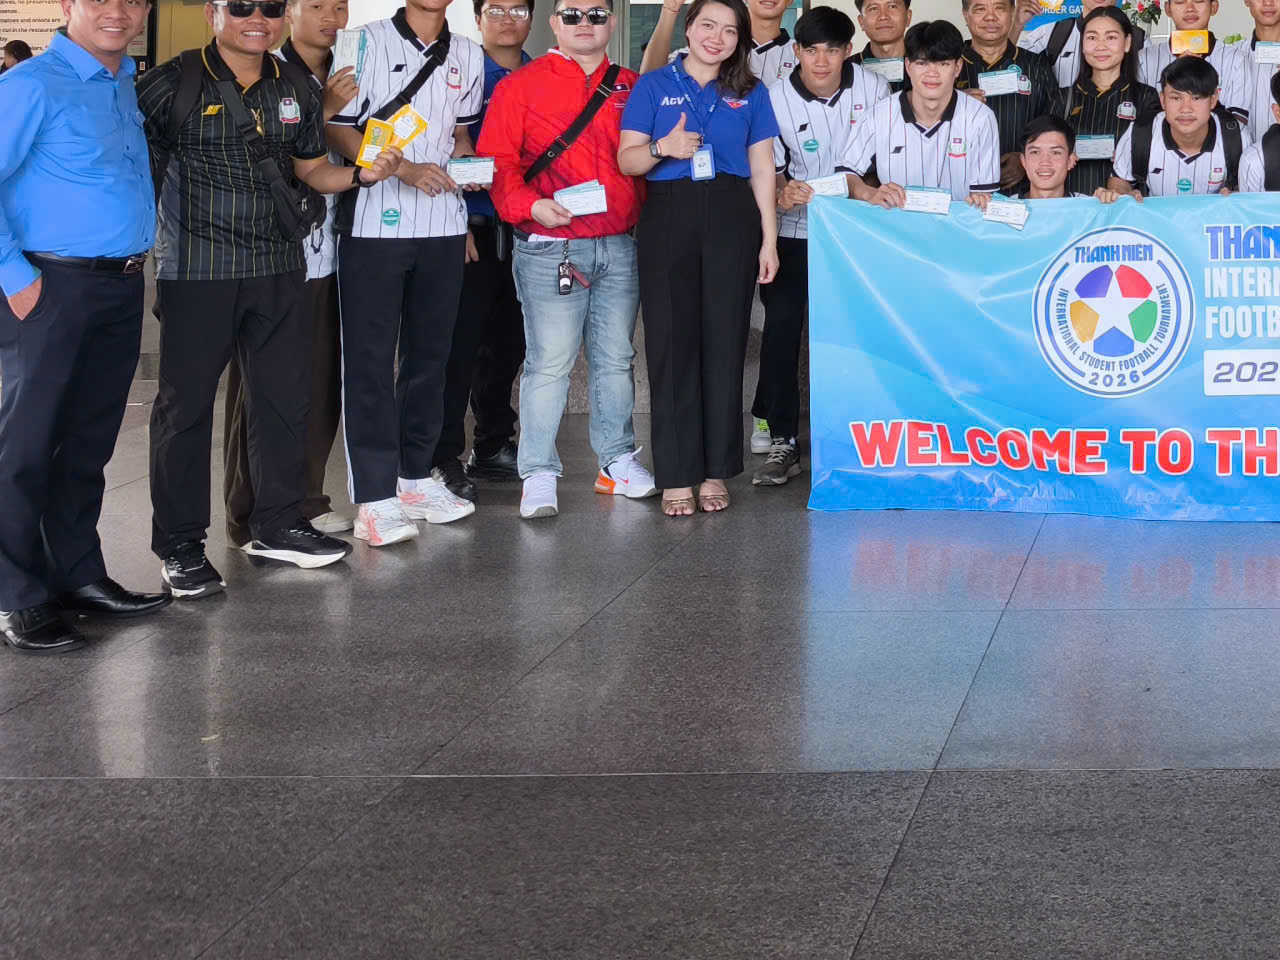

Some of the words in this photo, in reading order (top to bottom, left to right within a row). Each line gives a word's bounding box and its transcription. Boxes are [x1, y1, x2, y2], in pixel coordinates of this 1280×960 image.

[1074, 245, 1120, 263] THANH
[1055, 287, 1081, 356] INTERNATIONAL
[1078, 351, 1116, 372] STUDENT
[1118, 342, 1159, 372] FOOTBALL
[1153, 282, 1171, 344] TOURNAMENT
[1088, 370, 1141, 388] 2026
[849, 419, 1109, 475] WELCOME
[1121, 428, 1195, 475] TO
